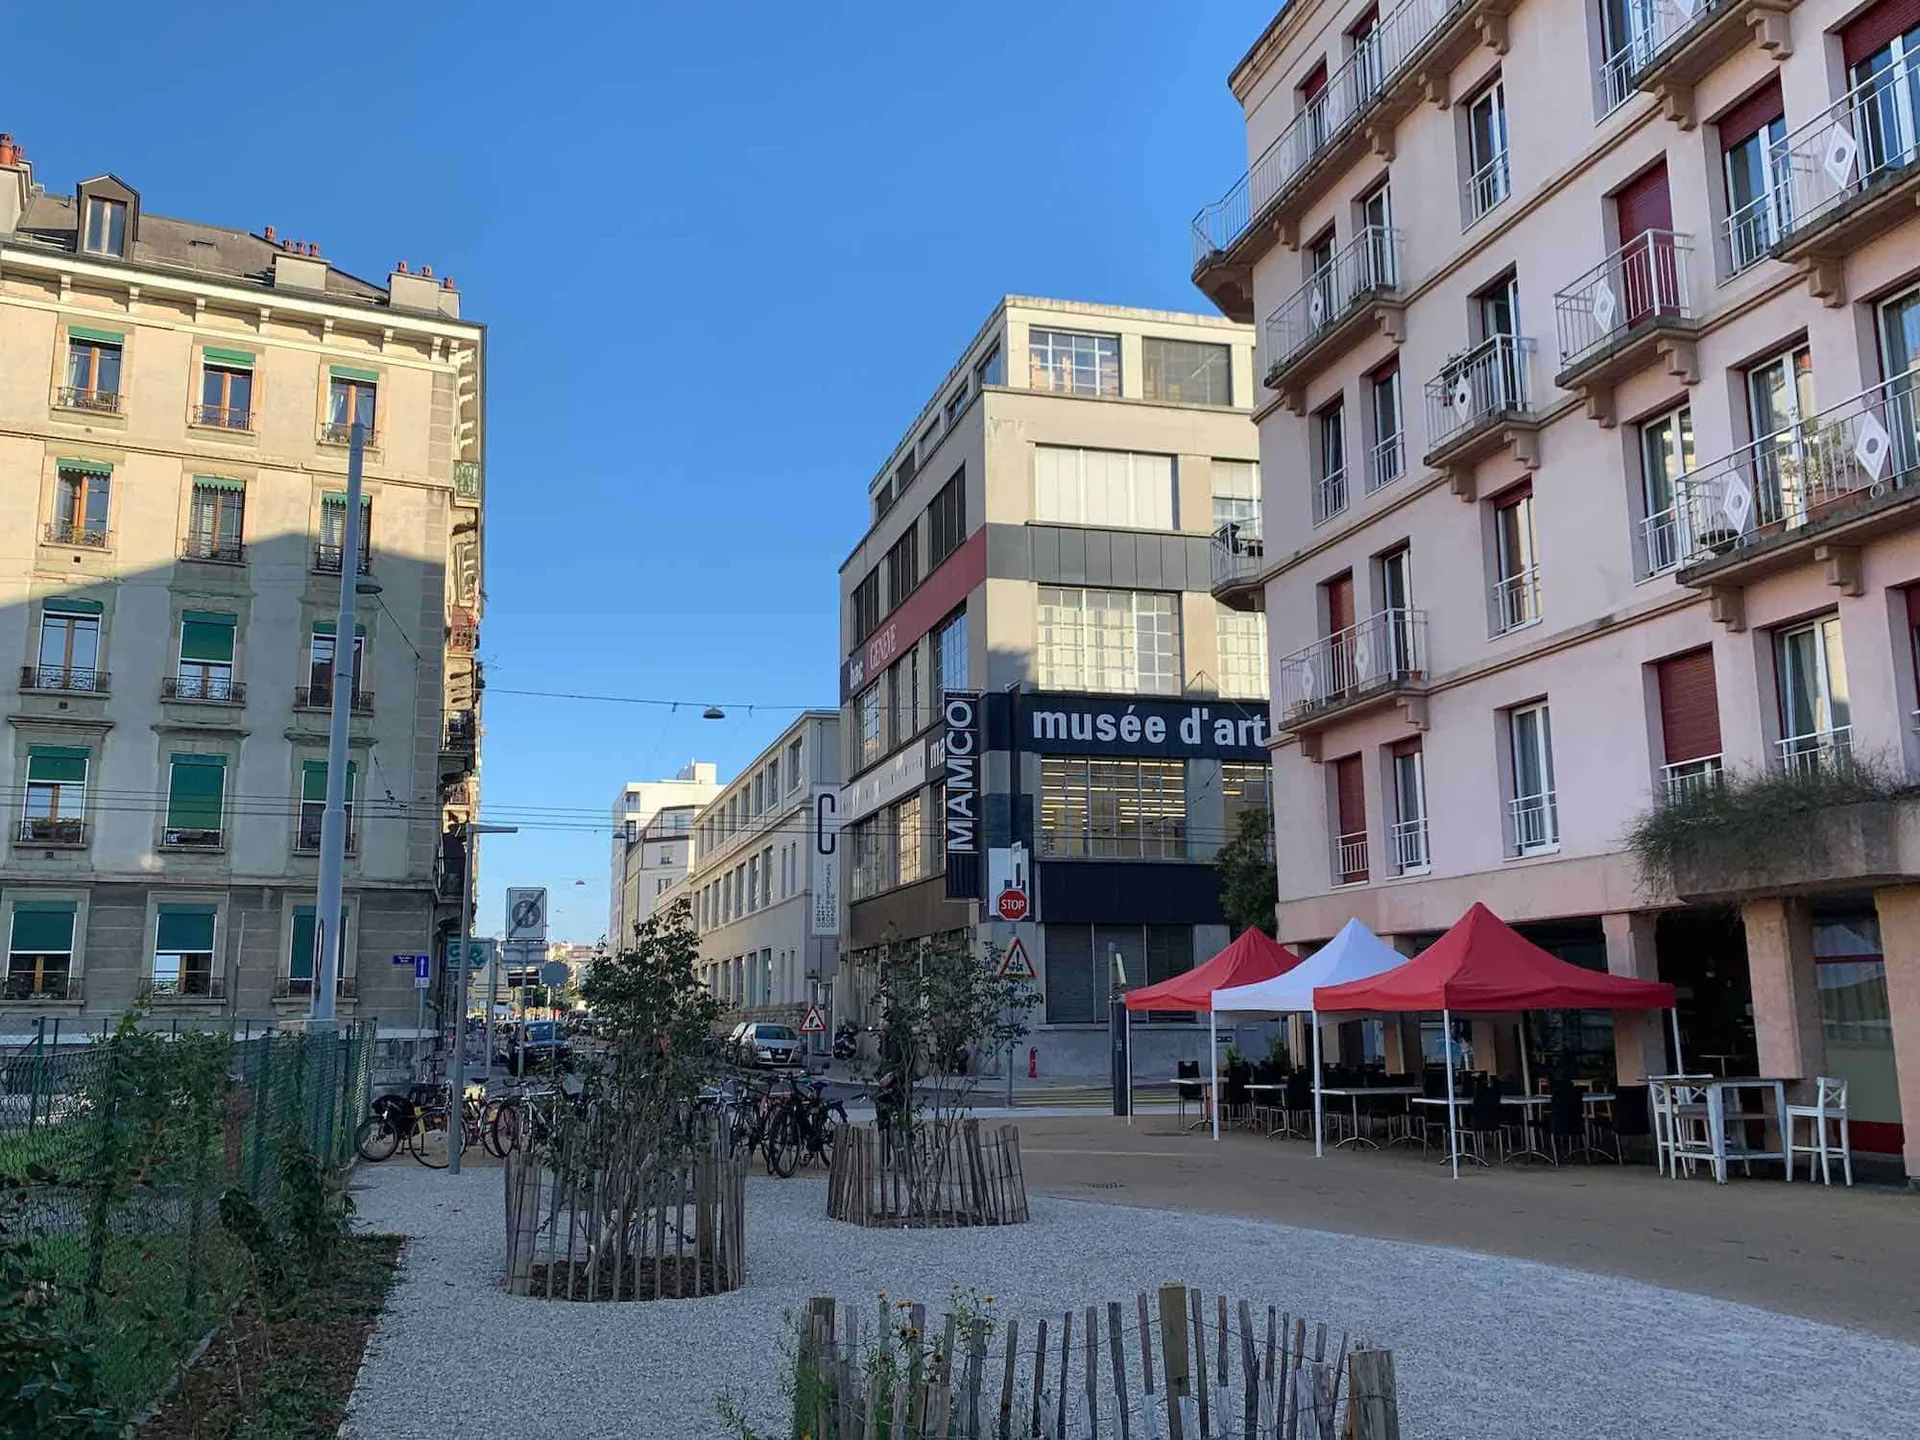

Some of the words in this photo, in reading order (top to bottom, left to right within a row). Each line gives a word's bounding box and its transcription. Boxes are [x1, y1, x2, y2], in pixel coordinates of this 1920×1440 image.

[1033, 704, 1166, 744] musée
[1180, 707, 1267, 747] d'art
[946, 701, 973, 850] MAMCO
[1000, 899, 1025, 911] STOP
